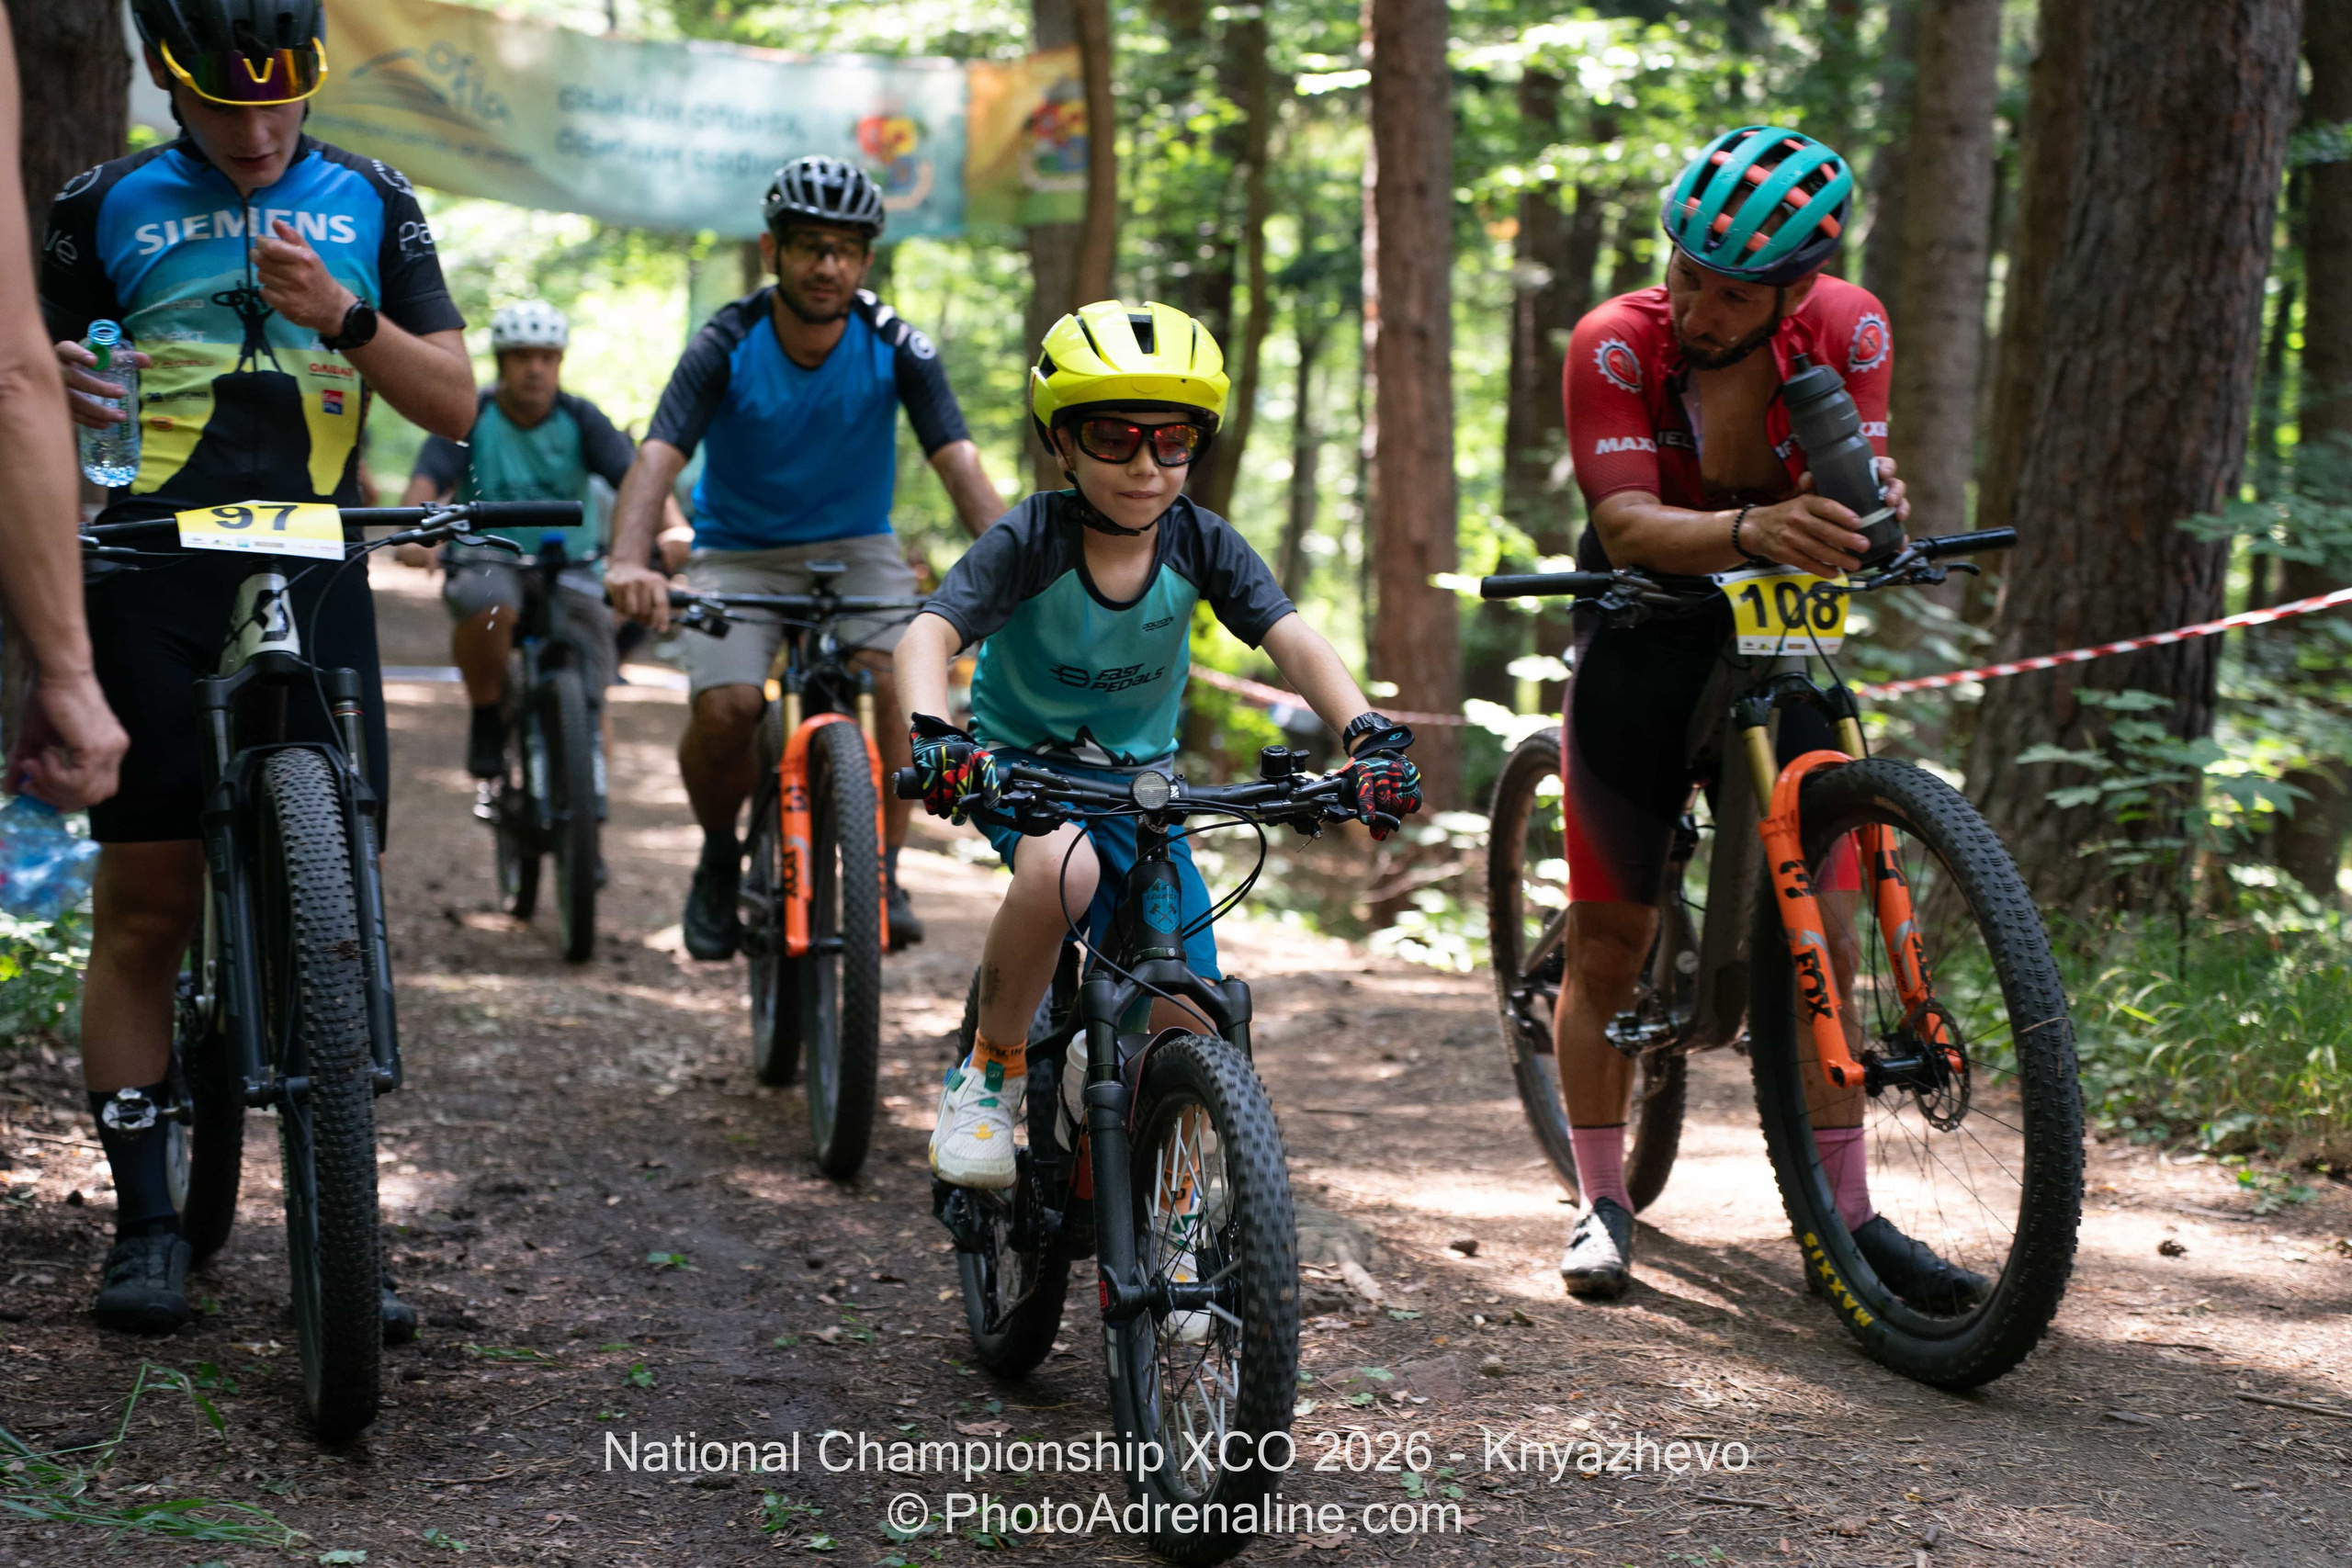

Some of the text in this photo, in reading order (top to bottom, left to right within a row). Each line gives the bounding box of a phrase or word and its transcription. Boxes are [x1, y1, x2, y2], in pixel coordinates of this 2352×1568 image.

[134, 207, 357, 255] SIEMENS
[210, 504, 299, 531] 97
[1739, 581, 1840, 630] 108
[1795, 948, 1834, 1021] FOX
[1803, 1232, 1874, 1327] MAXXIS
